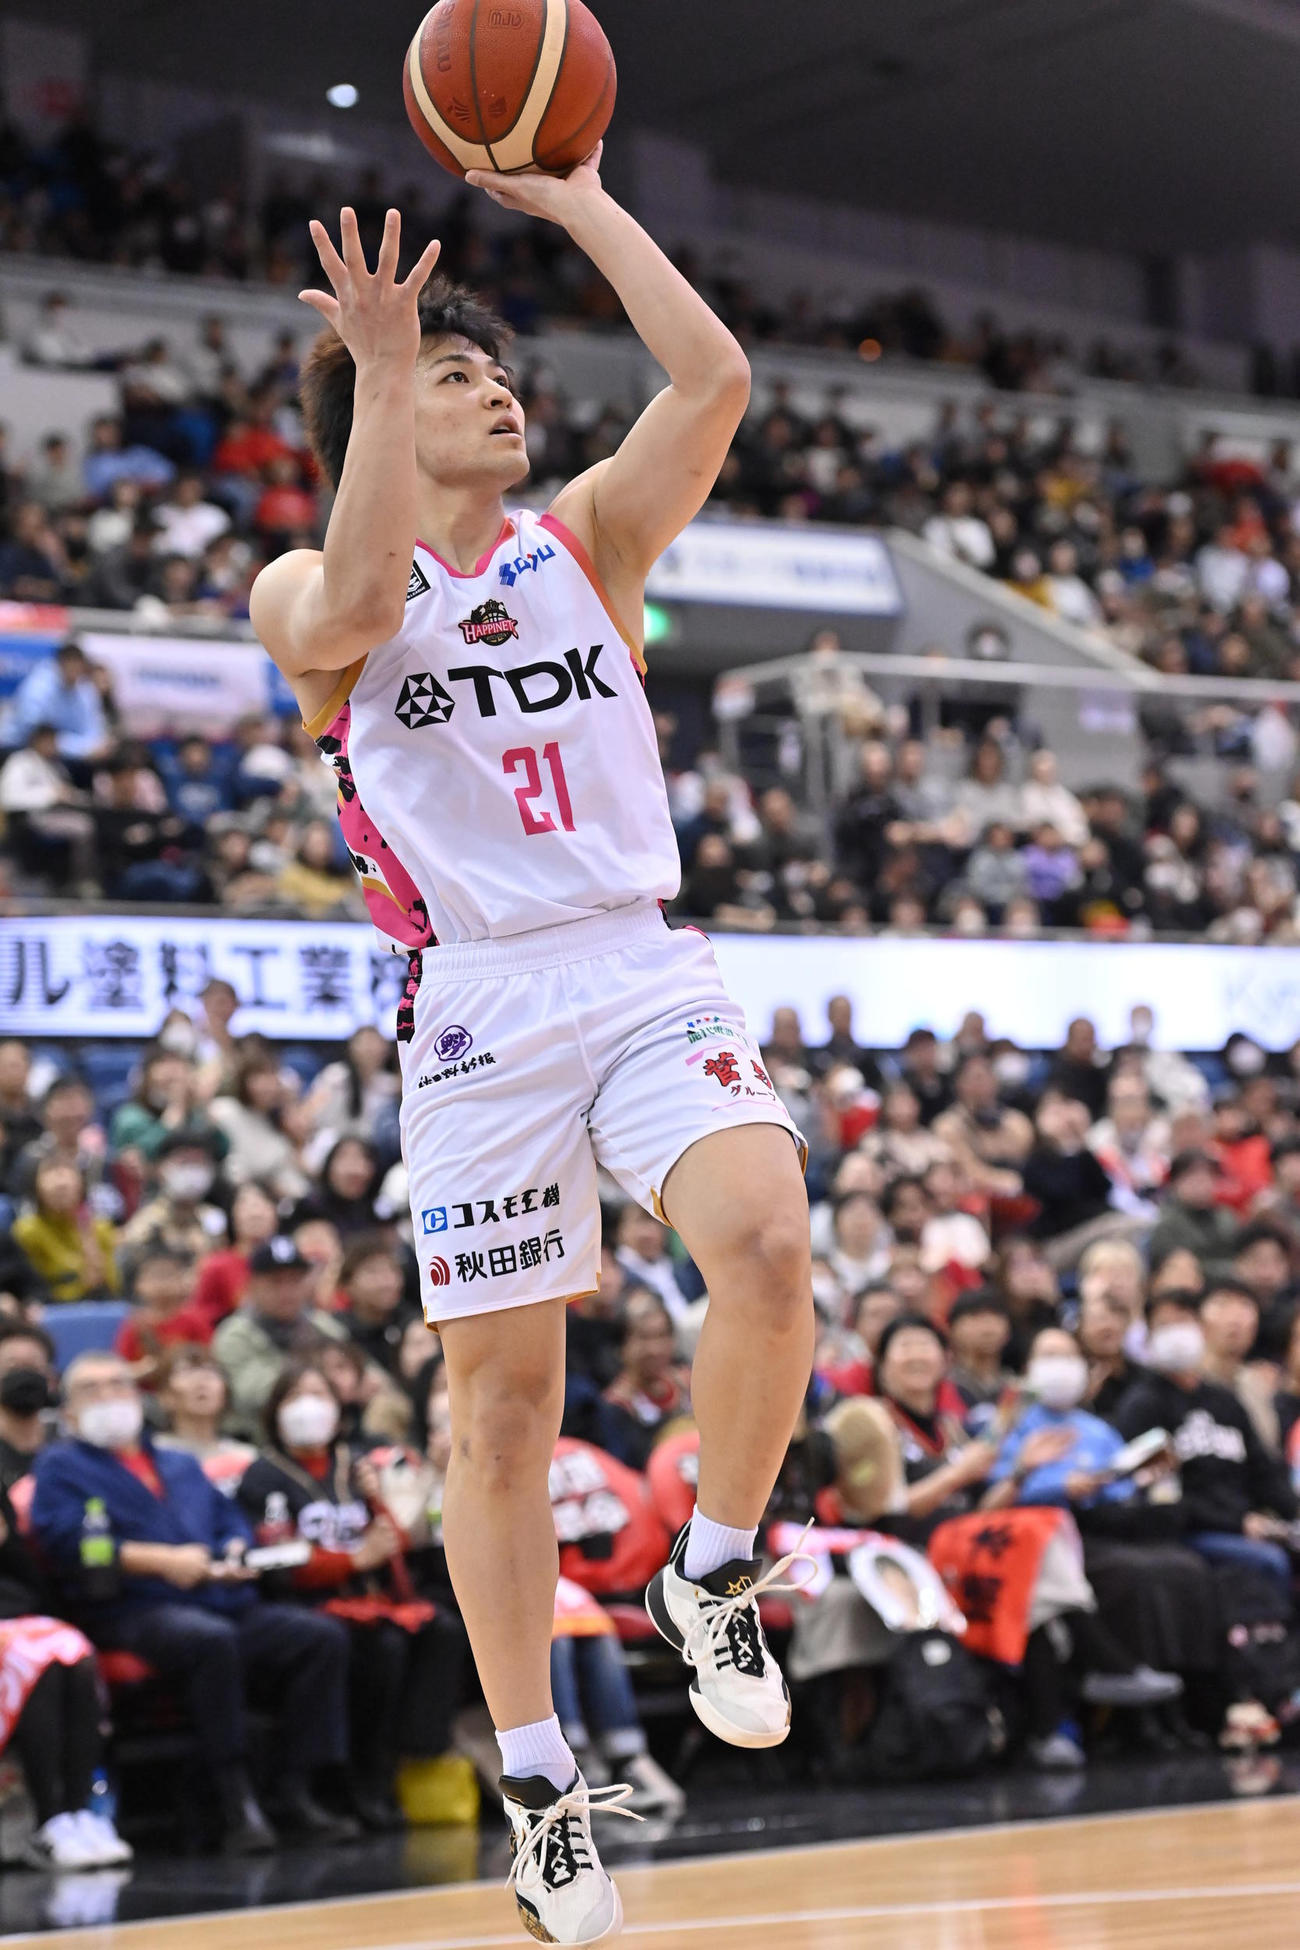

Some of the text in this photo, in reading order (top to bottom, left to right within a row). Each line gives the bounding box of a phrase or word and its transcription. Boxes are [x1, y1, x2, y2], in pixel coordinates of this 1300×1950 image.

[447, 645, 618, 717] TDK
[502, 742, 577, 836] 21
[452, 1182, 560, 1229] コスモ工機
[454, 1229, 565, 1283] 秋田銀行
